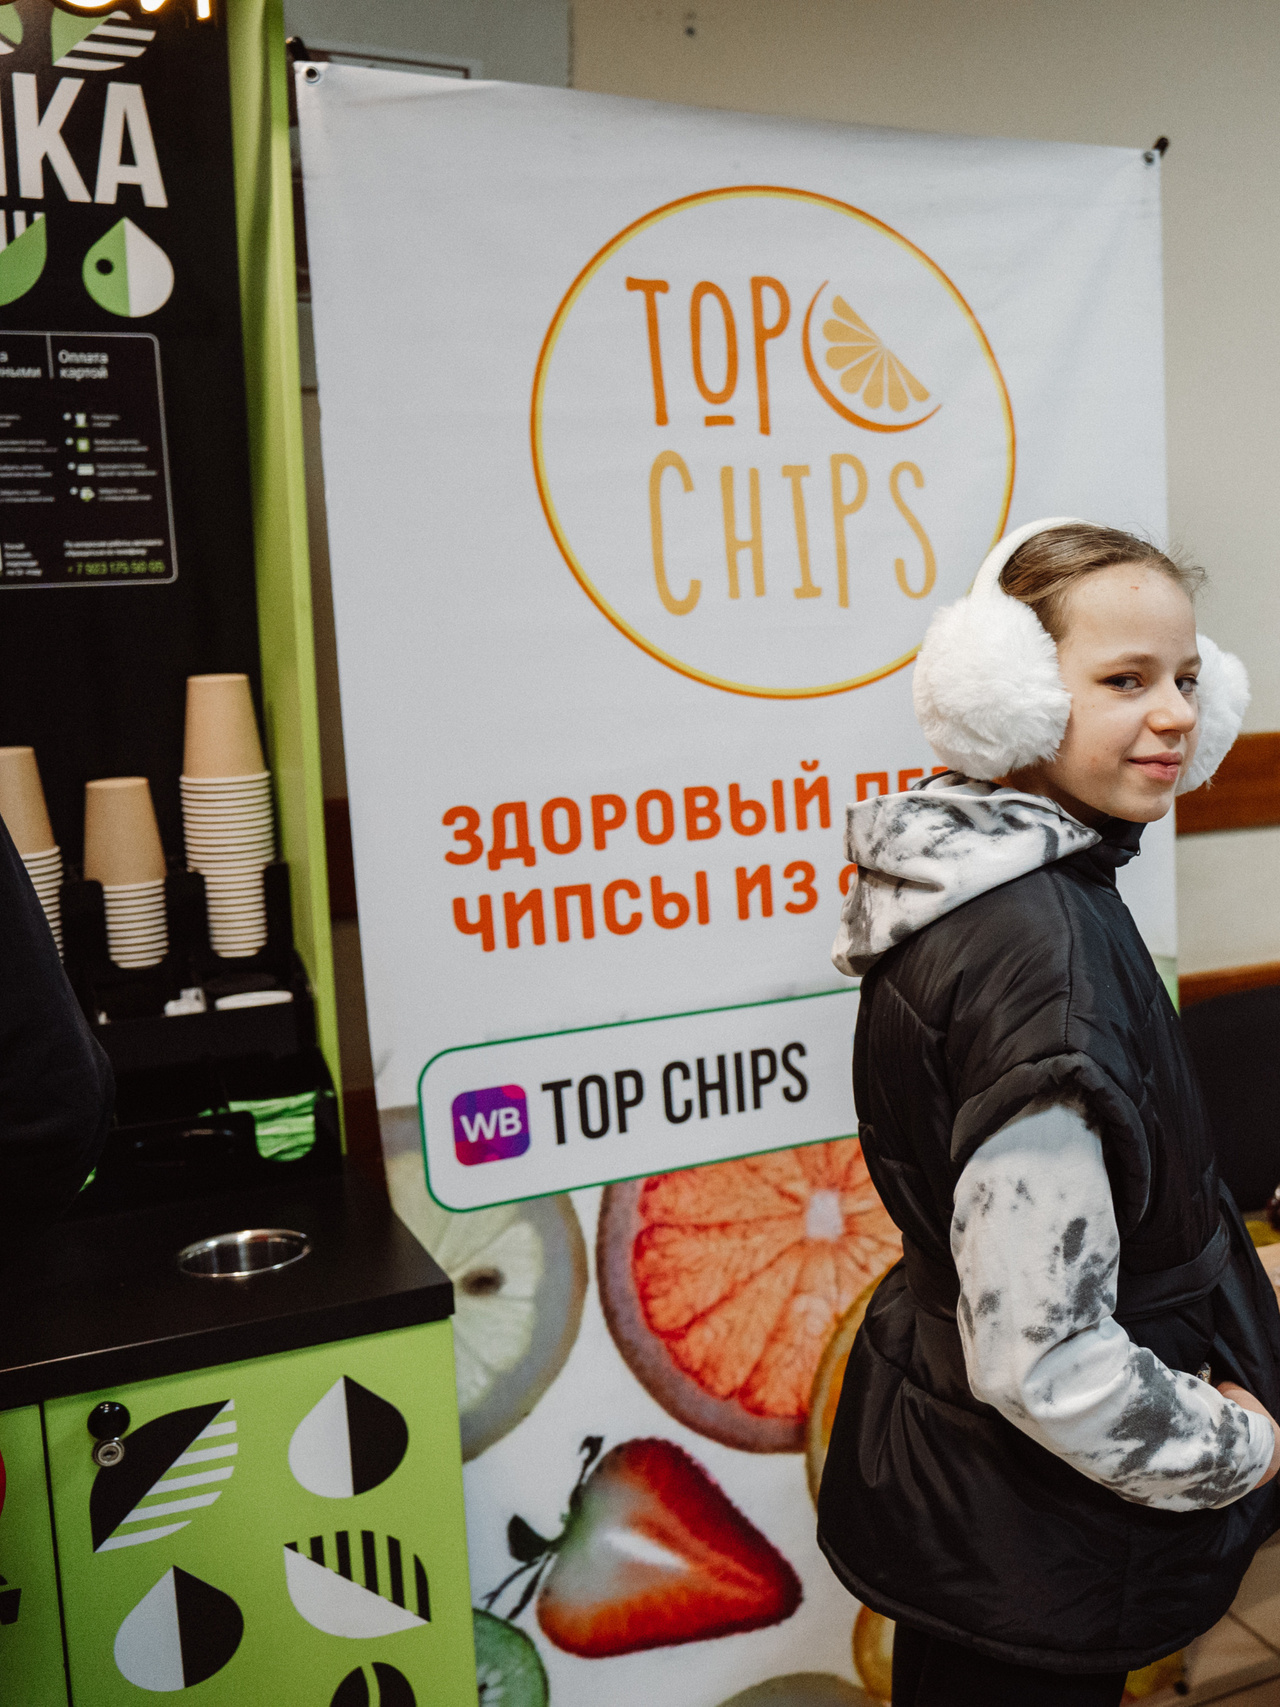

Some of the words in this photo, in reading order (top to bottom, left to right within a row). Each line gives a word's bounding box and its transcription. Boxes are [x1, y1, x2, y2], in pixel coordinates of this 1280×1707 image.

[0, 72, 168, 208] КА
[625, 275, 791, 436] TOP
[649, 450, 938, 616] CHIPS
[441, 759, 832, 871] ЗДОРОВЫЙ
[452, 870, 710, 953] ЧИПСЫ
[735, 860, 819, 920] ИЗ
[460, 1108, 522, 1143] WB
[541, 1067, 645, 1146] TOP
[662, 1042, 809, 1126] CHIPS
